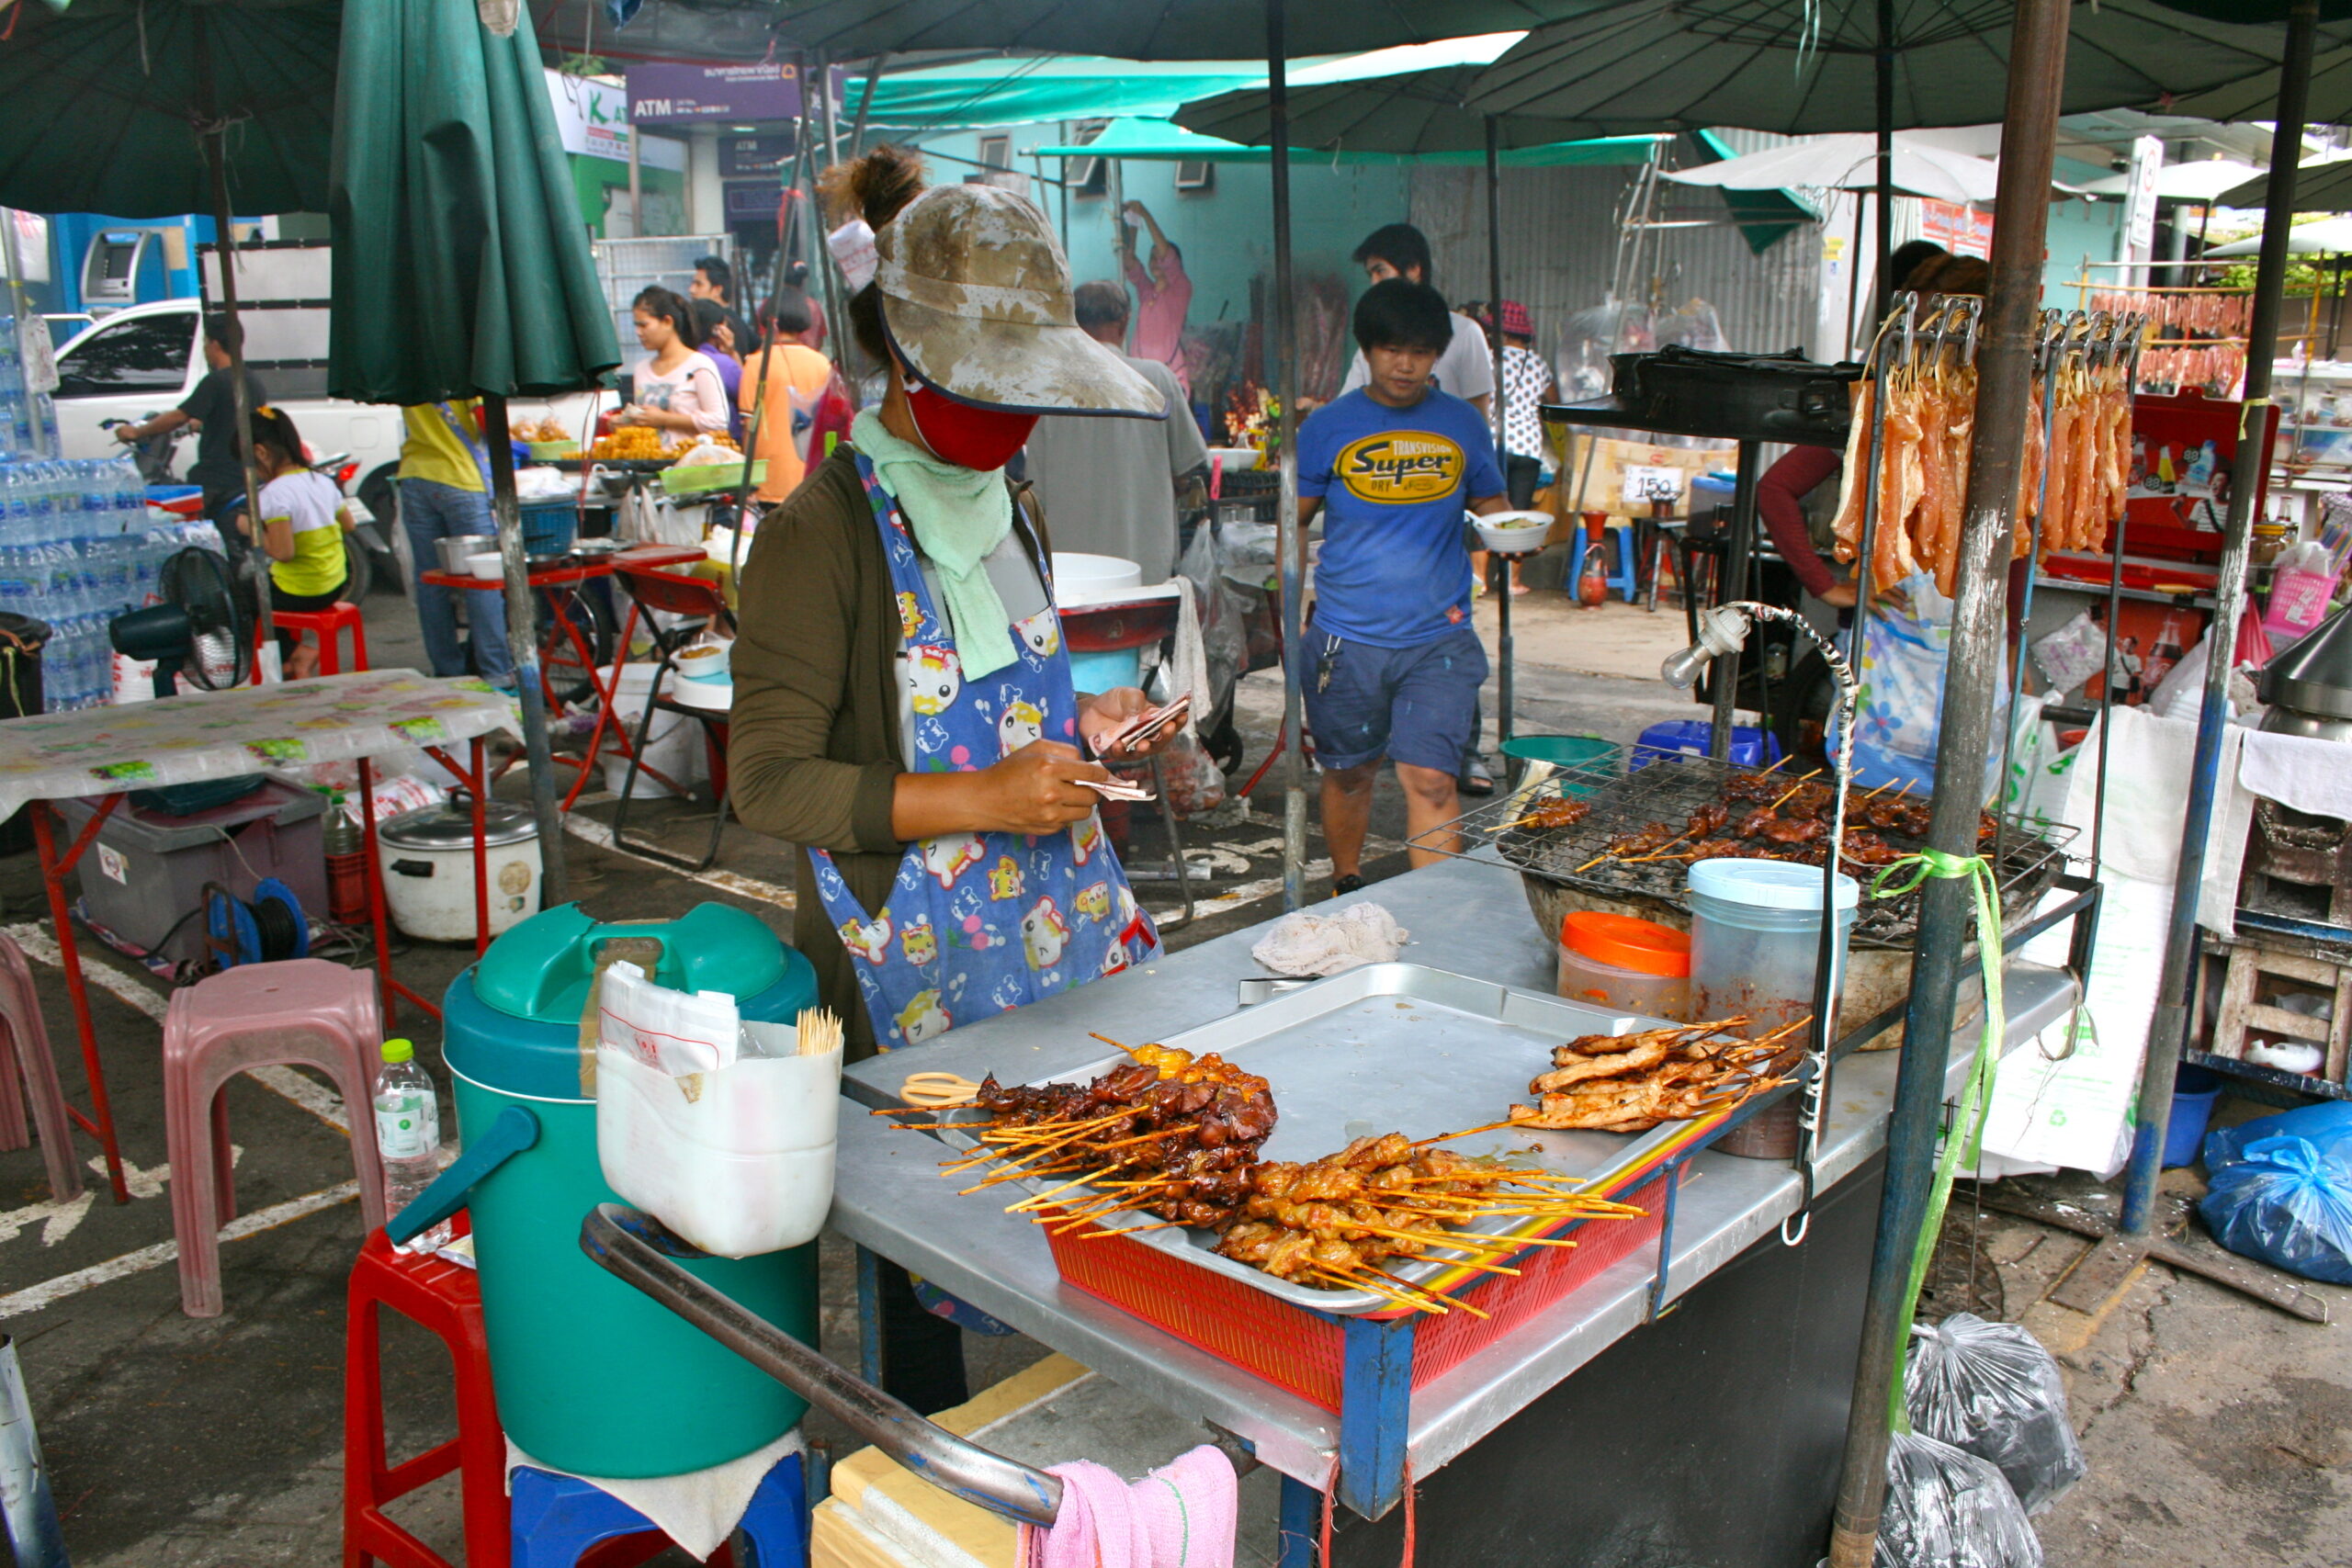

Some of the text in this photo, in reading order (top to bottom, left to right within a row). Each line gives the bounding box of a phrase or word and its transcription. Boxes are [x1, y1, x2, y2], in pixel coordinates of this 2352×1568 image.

[634, 98, 672, 118] ATM
[735, 140, 758, 152] ATM
[1392, 440, 1453, 457] TRANSVISION
[1348, 441, 1453, 488] Super
[1370, 480, 1391, 493] DRY
[1635, 477, 1672, 498] 150
